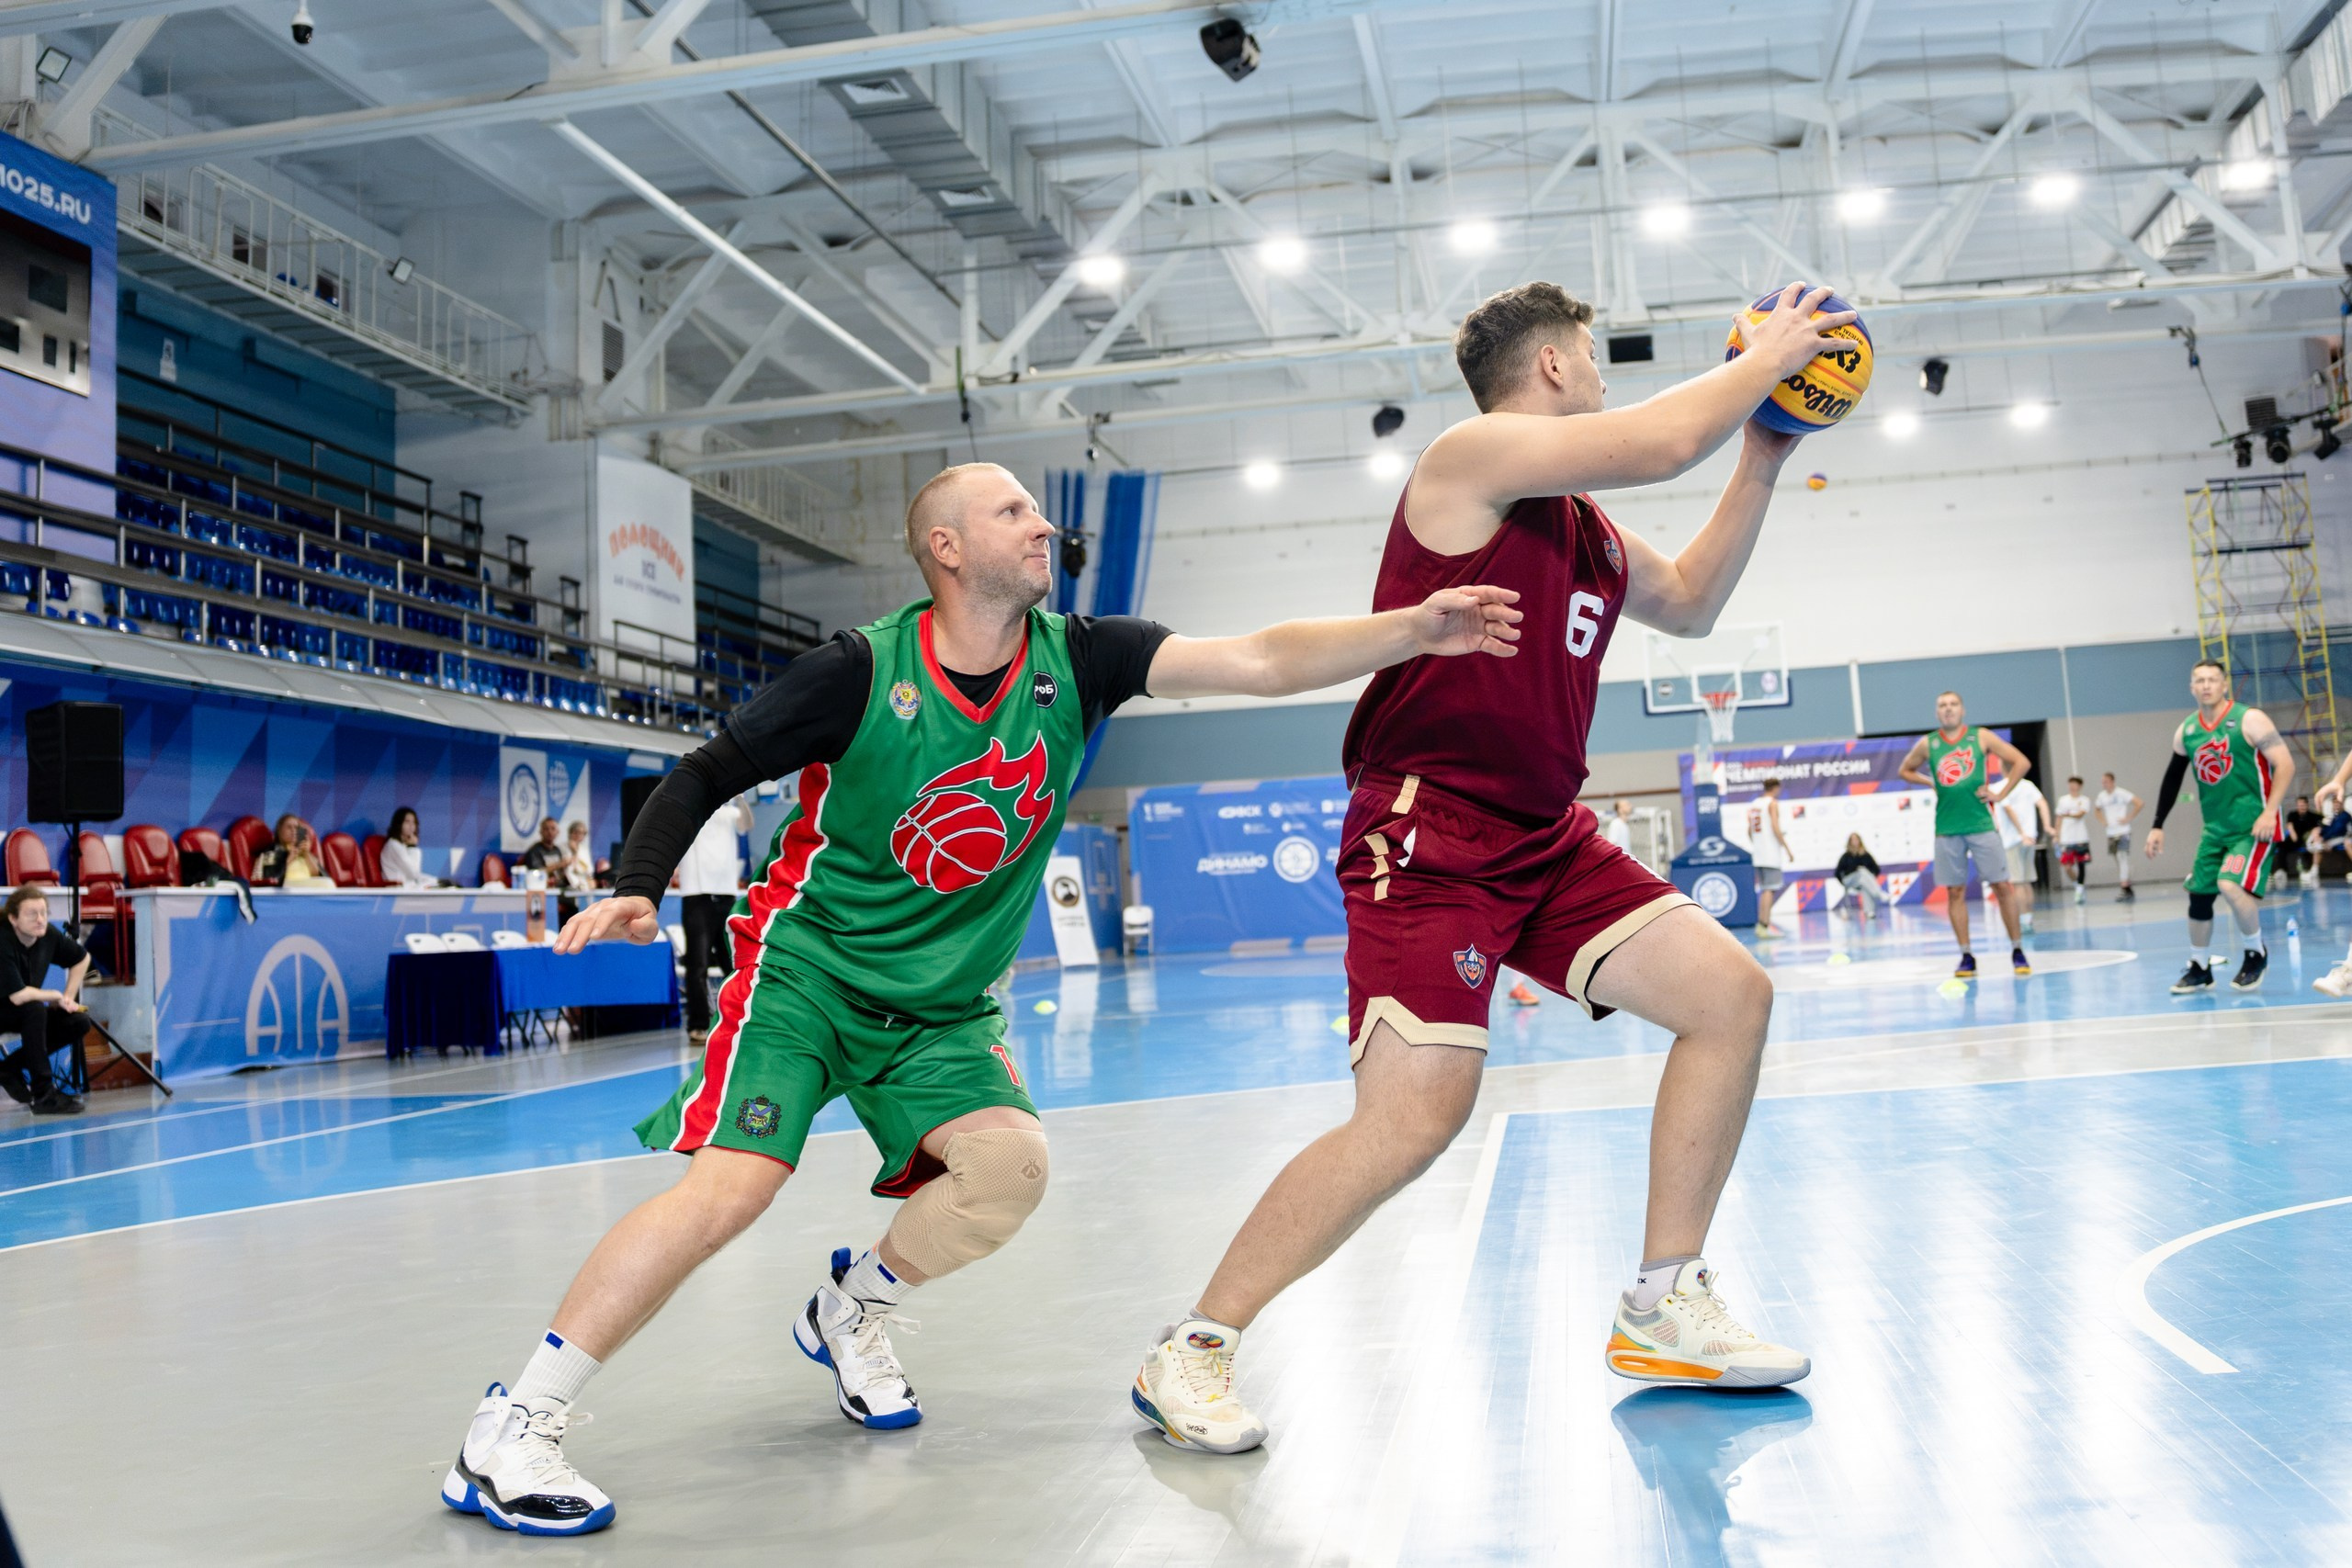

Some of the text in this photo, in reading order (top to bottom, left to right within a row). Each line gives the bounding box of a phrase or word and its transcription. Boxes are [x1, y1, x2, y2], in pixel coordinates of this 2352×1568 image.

[0, 163, 90, 225] O25.RU
[1781, 374, 1852, 419] Wilso
[1566, 591, 1605, 659] 6
[1726, 763, 1812, 783] ЧЕМПИОНАТ
[1814, 760, 1871, 778] РОССИИ
